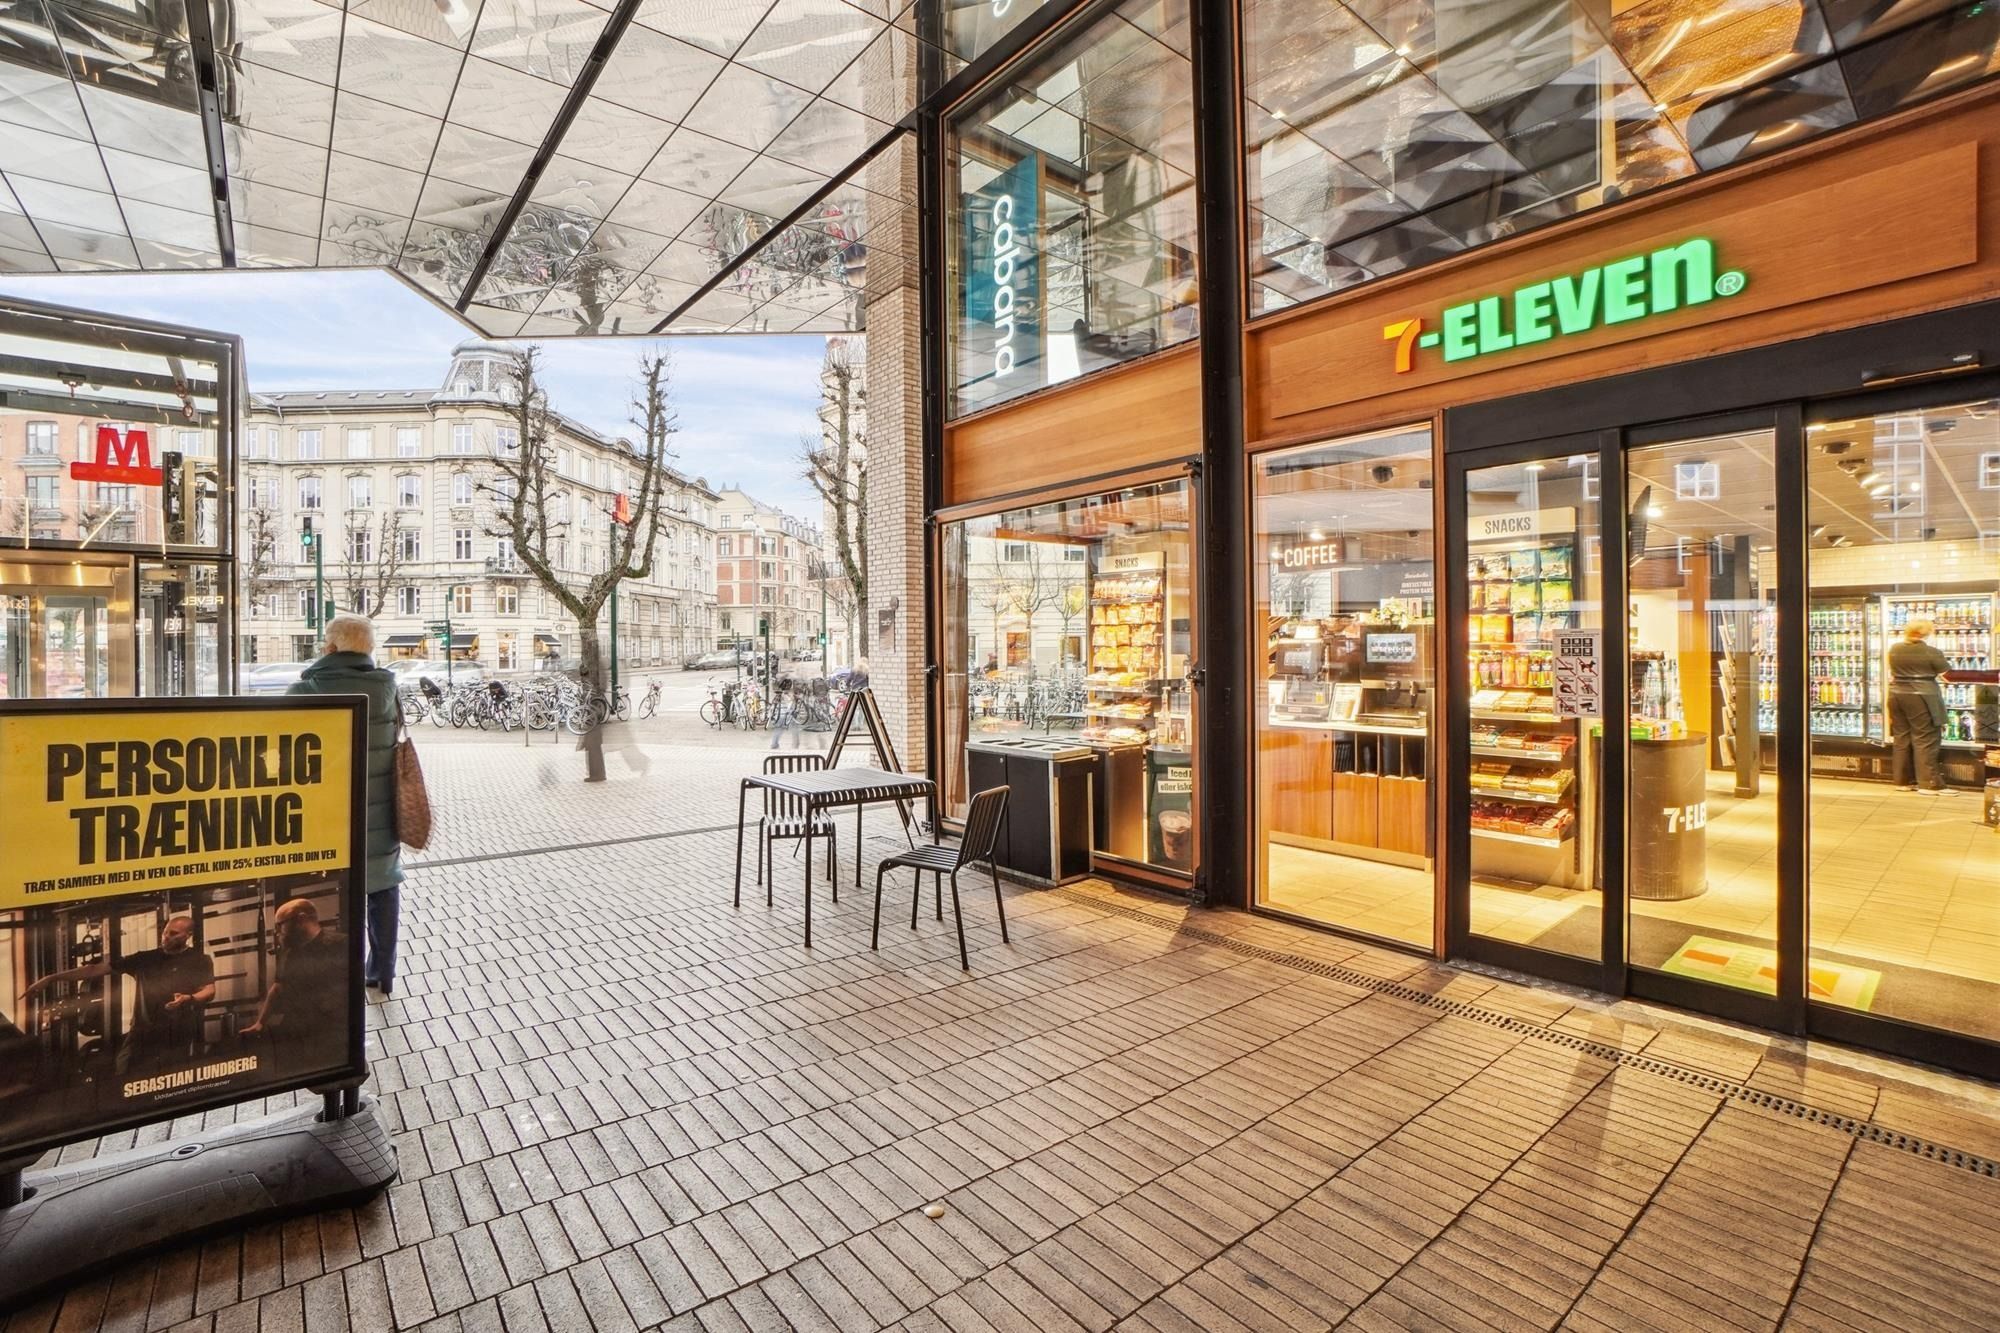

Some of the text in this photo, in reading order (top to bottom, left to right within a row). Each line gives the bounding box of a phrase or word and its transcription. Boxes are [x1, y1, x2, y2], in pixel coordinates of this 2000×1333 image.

[993, 194, 1020, 378] cabana
[1484, 516, 1531, 535] SNACKS
[1114, 557, 1139, 569] SNACKS
[1284, 544, 1337, 568] COFFEE
[47, 733, 322, 802] PERSONLIG
[70, 792, 303, 865] TRÆNING
[24, 848, 337, 894] TRÆN SAMMEN MED EN VEN OG BETAL KUN 25% EKSTRA FOR DIN VEN
[123, 1055, 257, 1098] SEBASTIAN LUNDBERG
